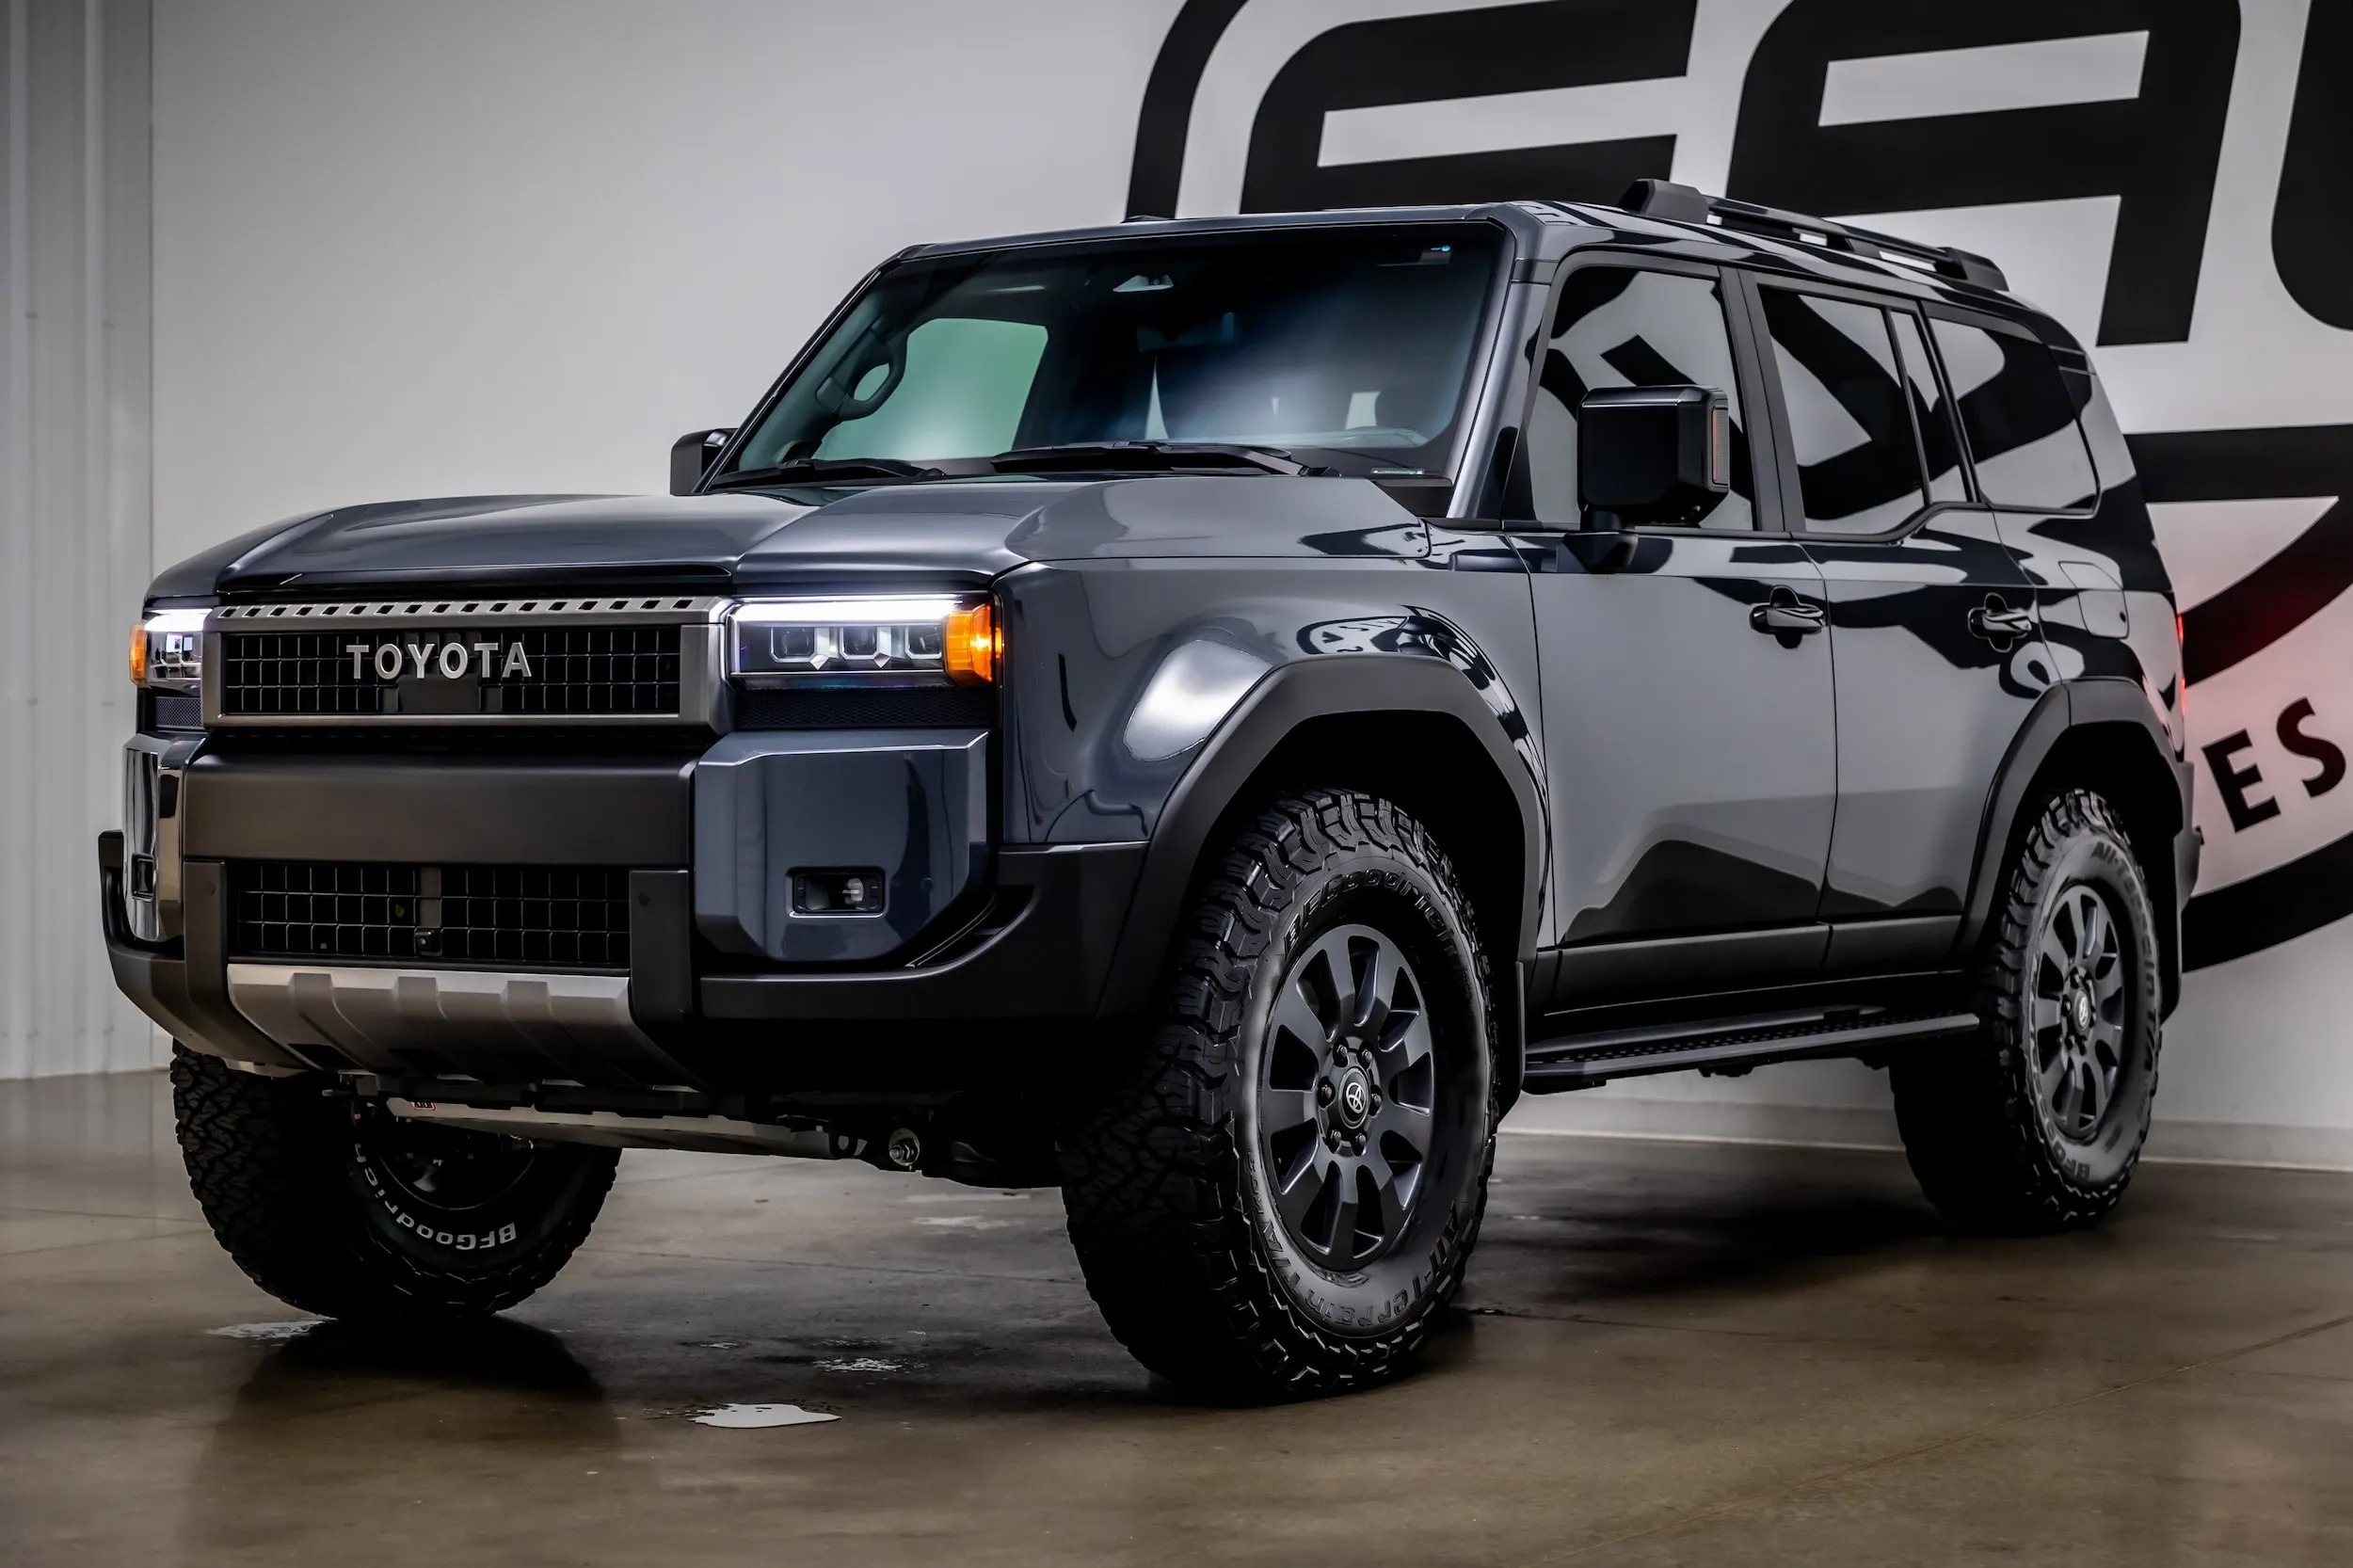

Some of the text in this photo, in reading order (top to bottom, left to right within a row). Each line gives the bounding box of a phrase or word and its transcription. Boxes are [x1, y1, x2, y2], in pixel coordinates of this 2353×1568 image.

[345, 642, 532, 680] TOYOTA
[2194, 696, 2346, 845] ES
[1283, 869, 1458, 961] BFGoodrich
[1304, 1200, 1460, 1326] All-Terrain
